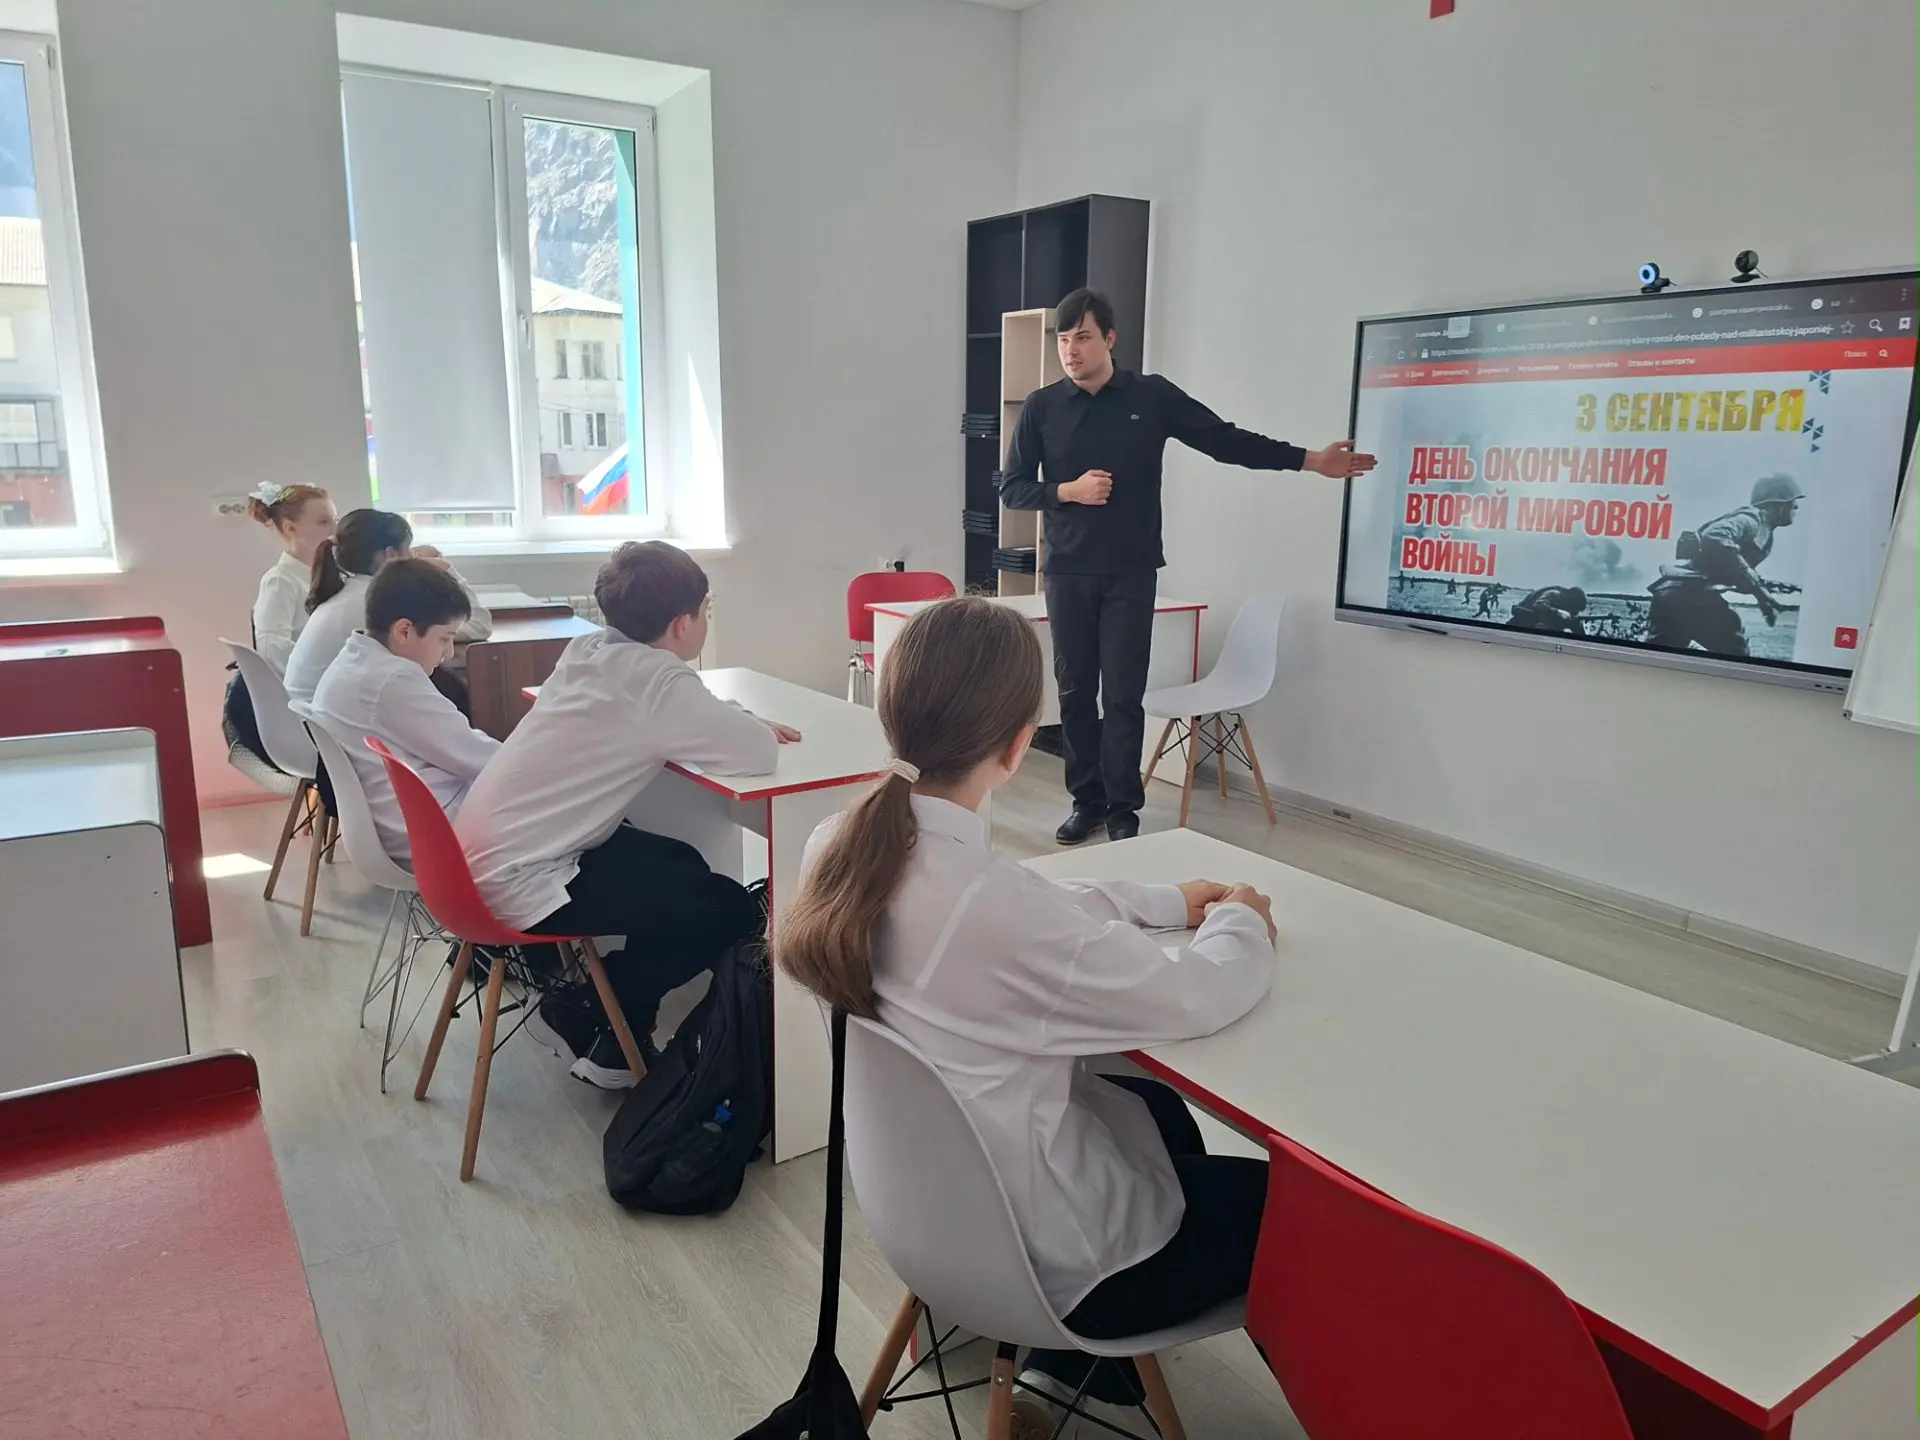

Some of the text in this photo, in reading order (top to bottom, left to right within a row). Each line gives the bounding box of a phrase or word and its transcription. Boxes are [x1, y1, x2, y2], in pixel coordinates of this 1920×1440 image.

[1575, 389, 1805, 432] 3 СЕНТЯБРЯ
[1408, 446, 1668, 486] ДЕНЬ ОКОНЧАНИЯ
[1405, 488, 1673, 540] ВТОРОЙ МИРОВОЙ
[1402, 532, 1497, 577] ВОЙНЫ
